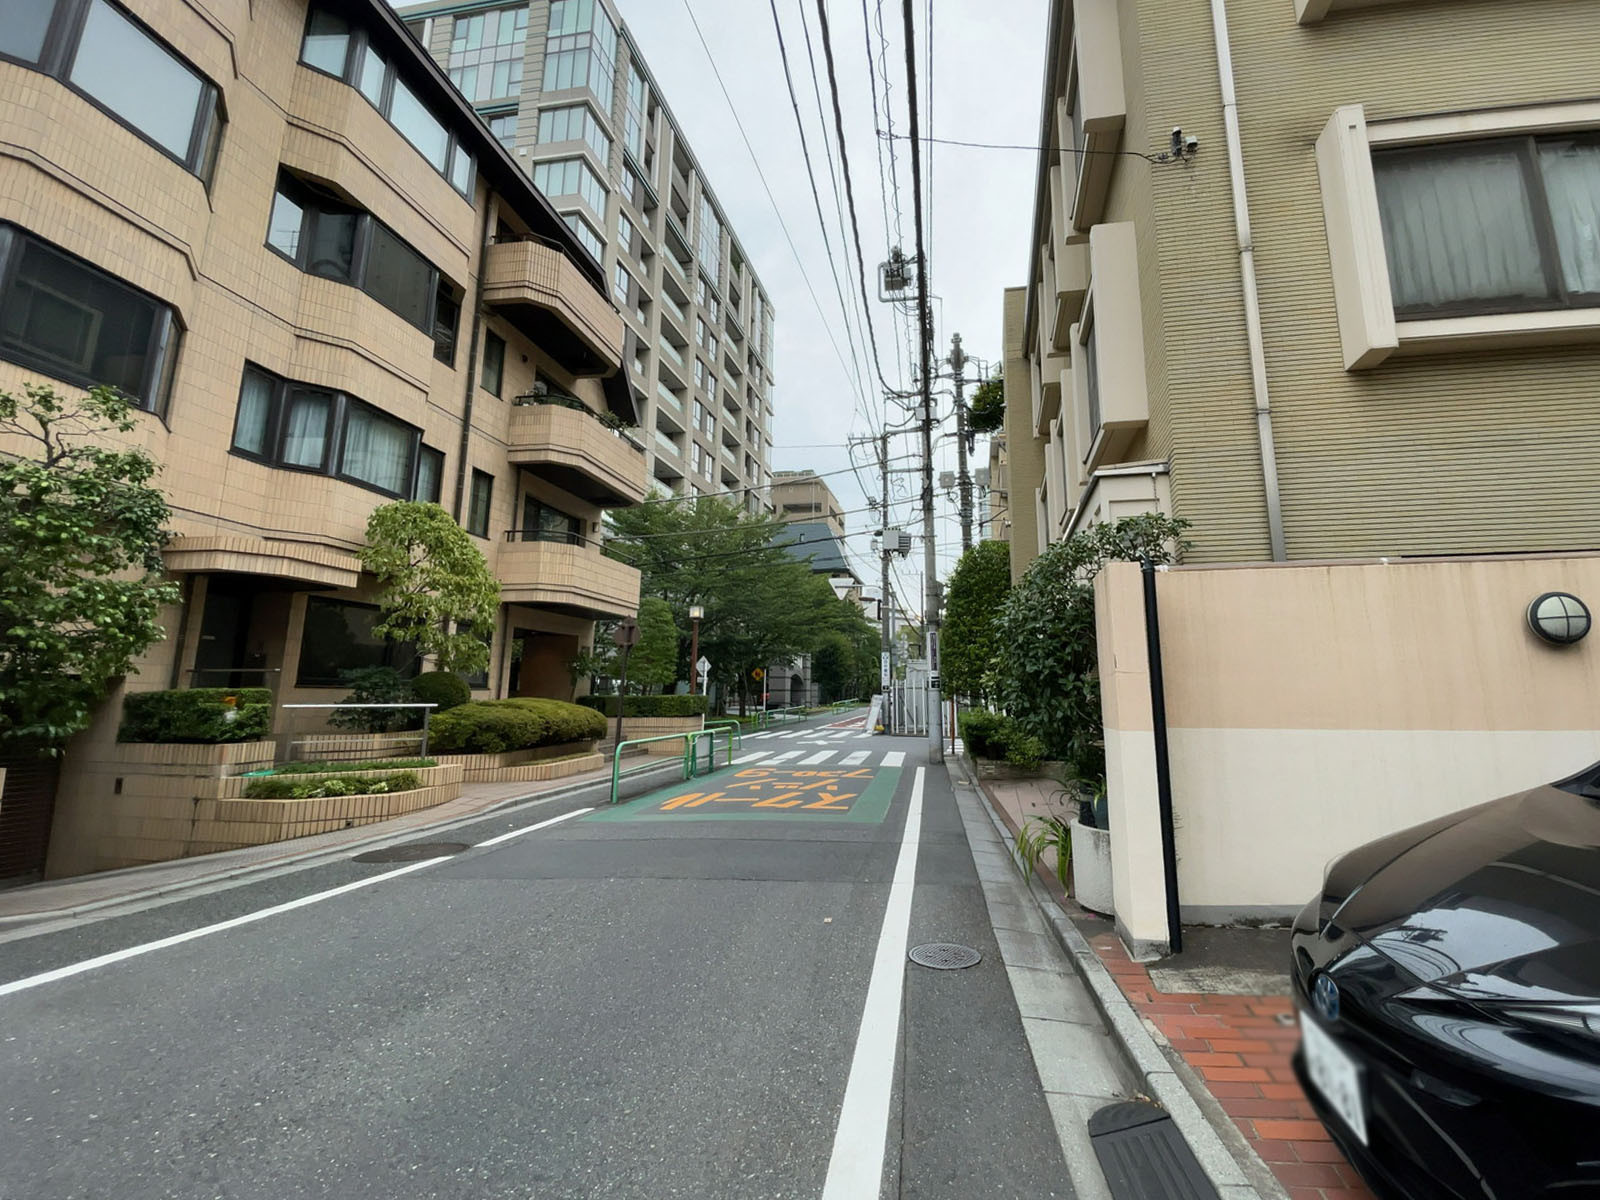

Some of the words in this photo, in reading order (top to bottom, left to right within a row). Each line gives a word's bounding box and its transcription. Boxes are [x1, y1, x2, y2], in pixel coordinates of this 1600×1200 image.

[726, 778, 839, 790] ゾーン
[659, 792, 858, 810] スクール
